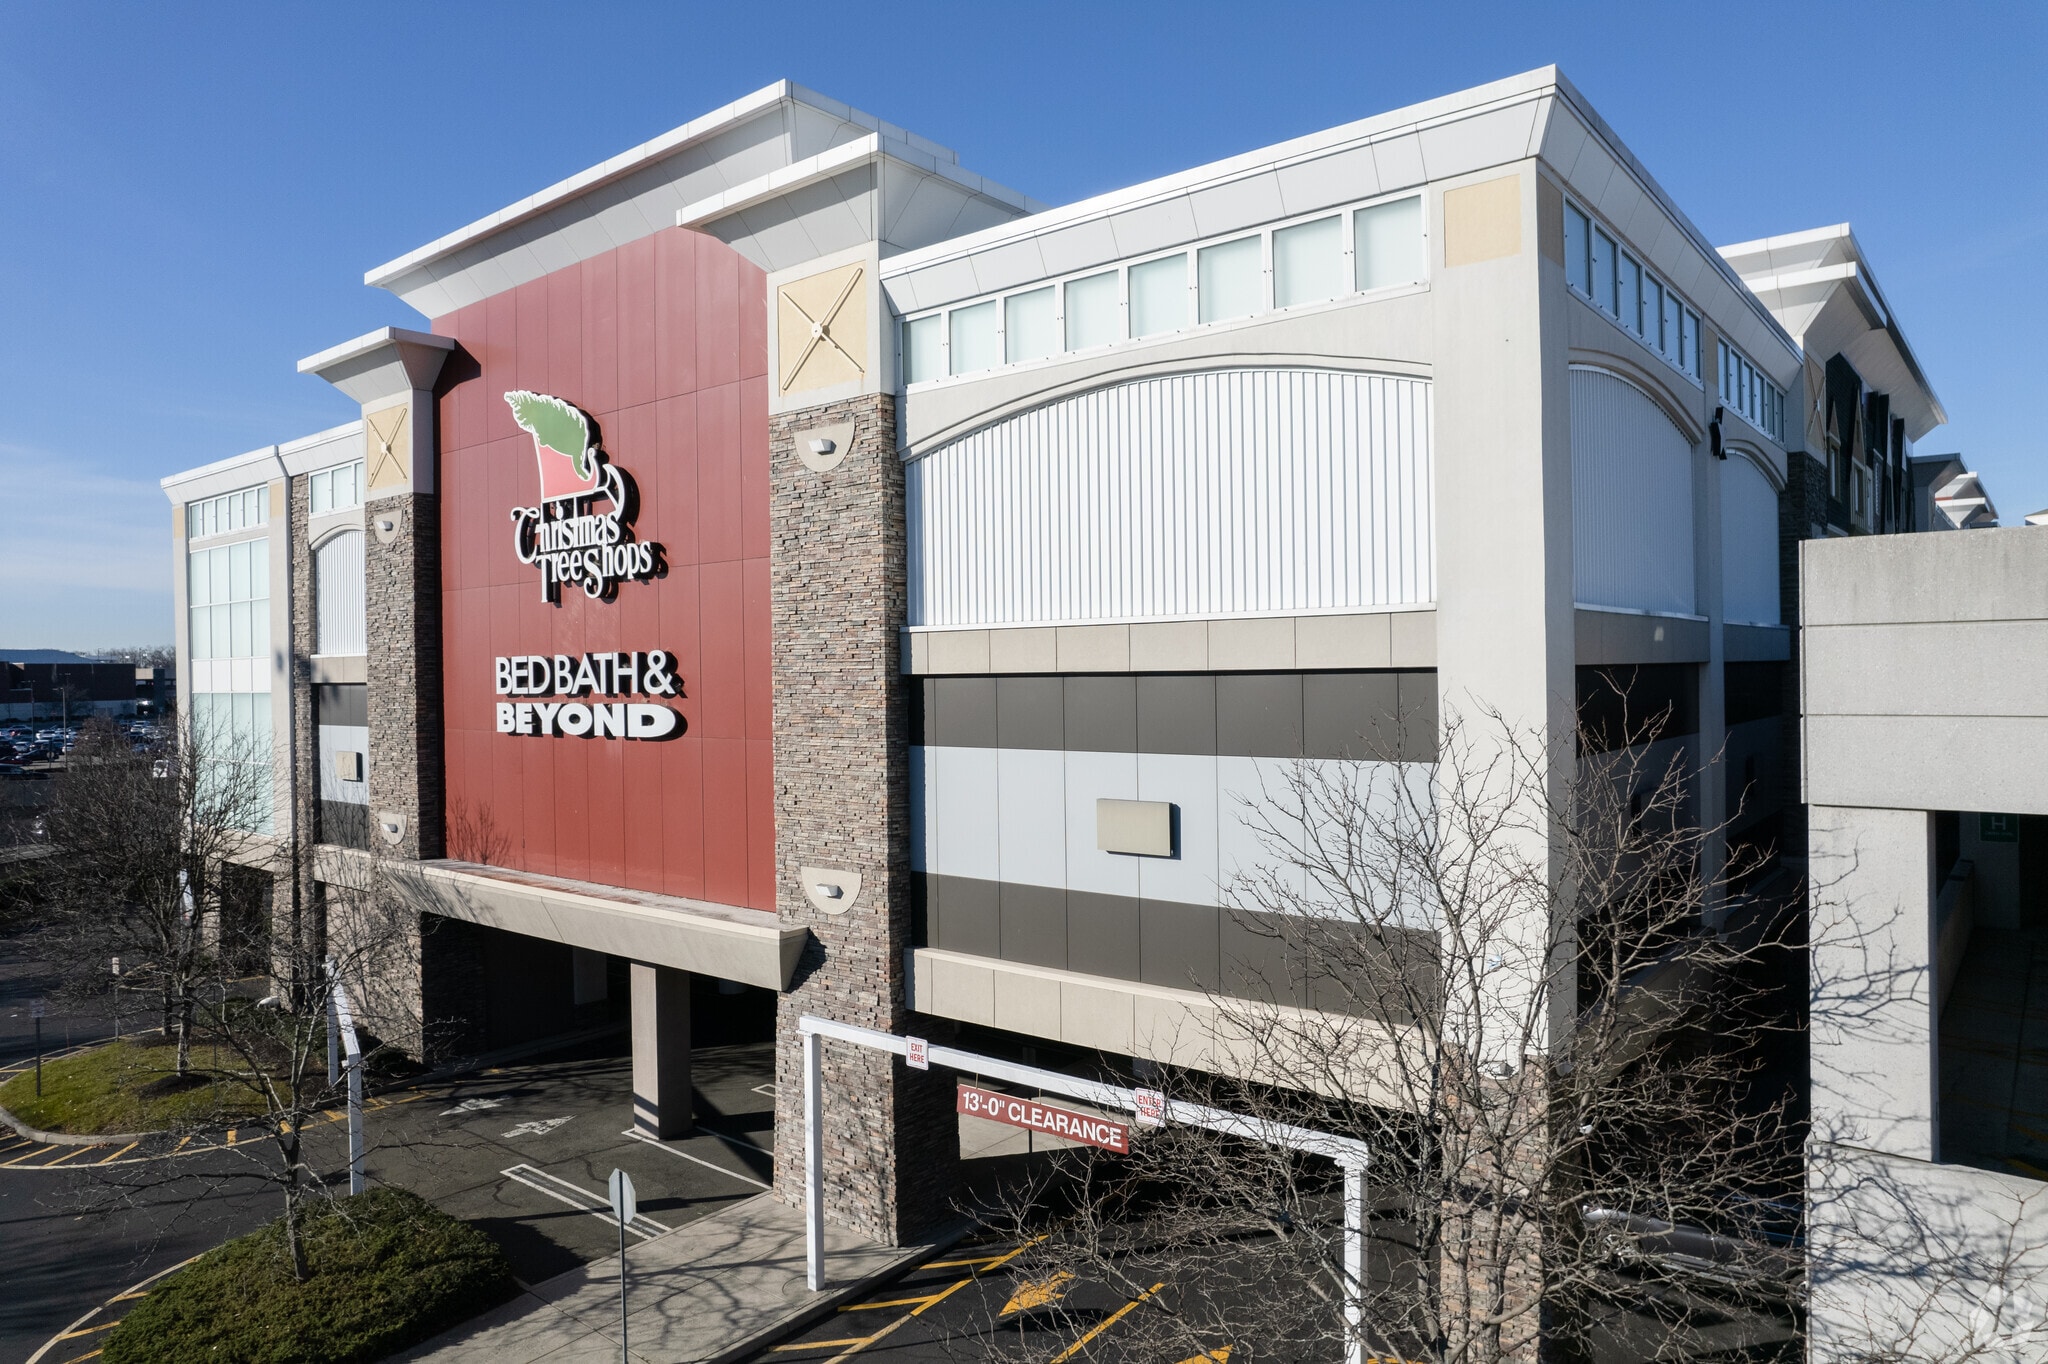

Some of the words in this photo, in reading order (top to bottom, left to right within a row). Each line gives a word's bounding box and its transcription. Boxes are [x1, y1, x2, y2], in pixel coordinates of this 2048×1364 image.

[510, 499, 621, 564] Christmas
[535, 549, 583, 603] Tree
[583, 541, 653, 599] Shops
[495, 655, 551, 695] BED
[554, 651, 639, 695] BATH
[643, 649, 676, 695] &
[496, 702, 677, 738] BEYOND
[909, 1052, 925, 1064] HERE
[910, 1042, 923, 1053] EXIT
[1138, 1094, 1162, 1108] ENTER
[1140, 1106, 1160, 1120] HERE
[962, 1091, 1006, 1117] 13'-0"
[1008, 1102, 1122, 1149] CLEARANCE
